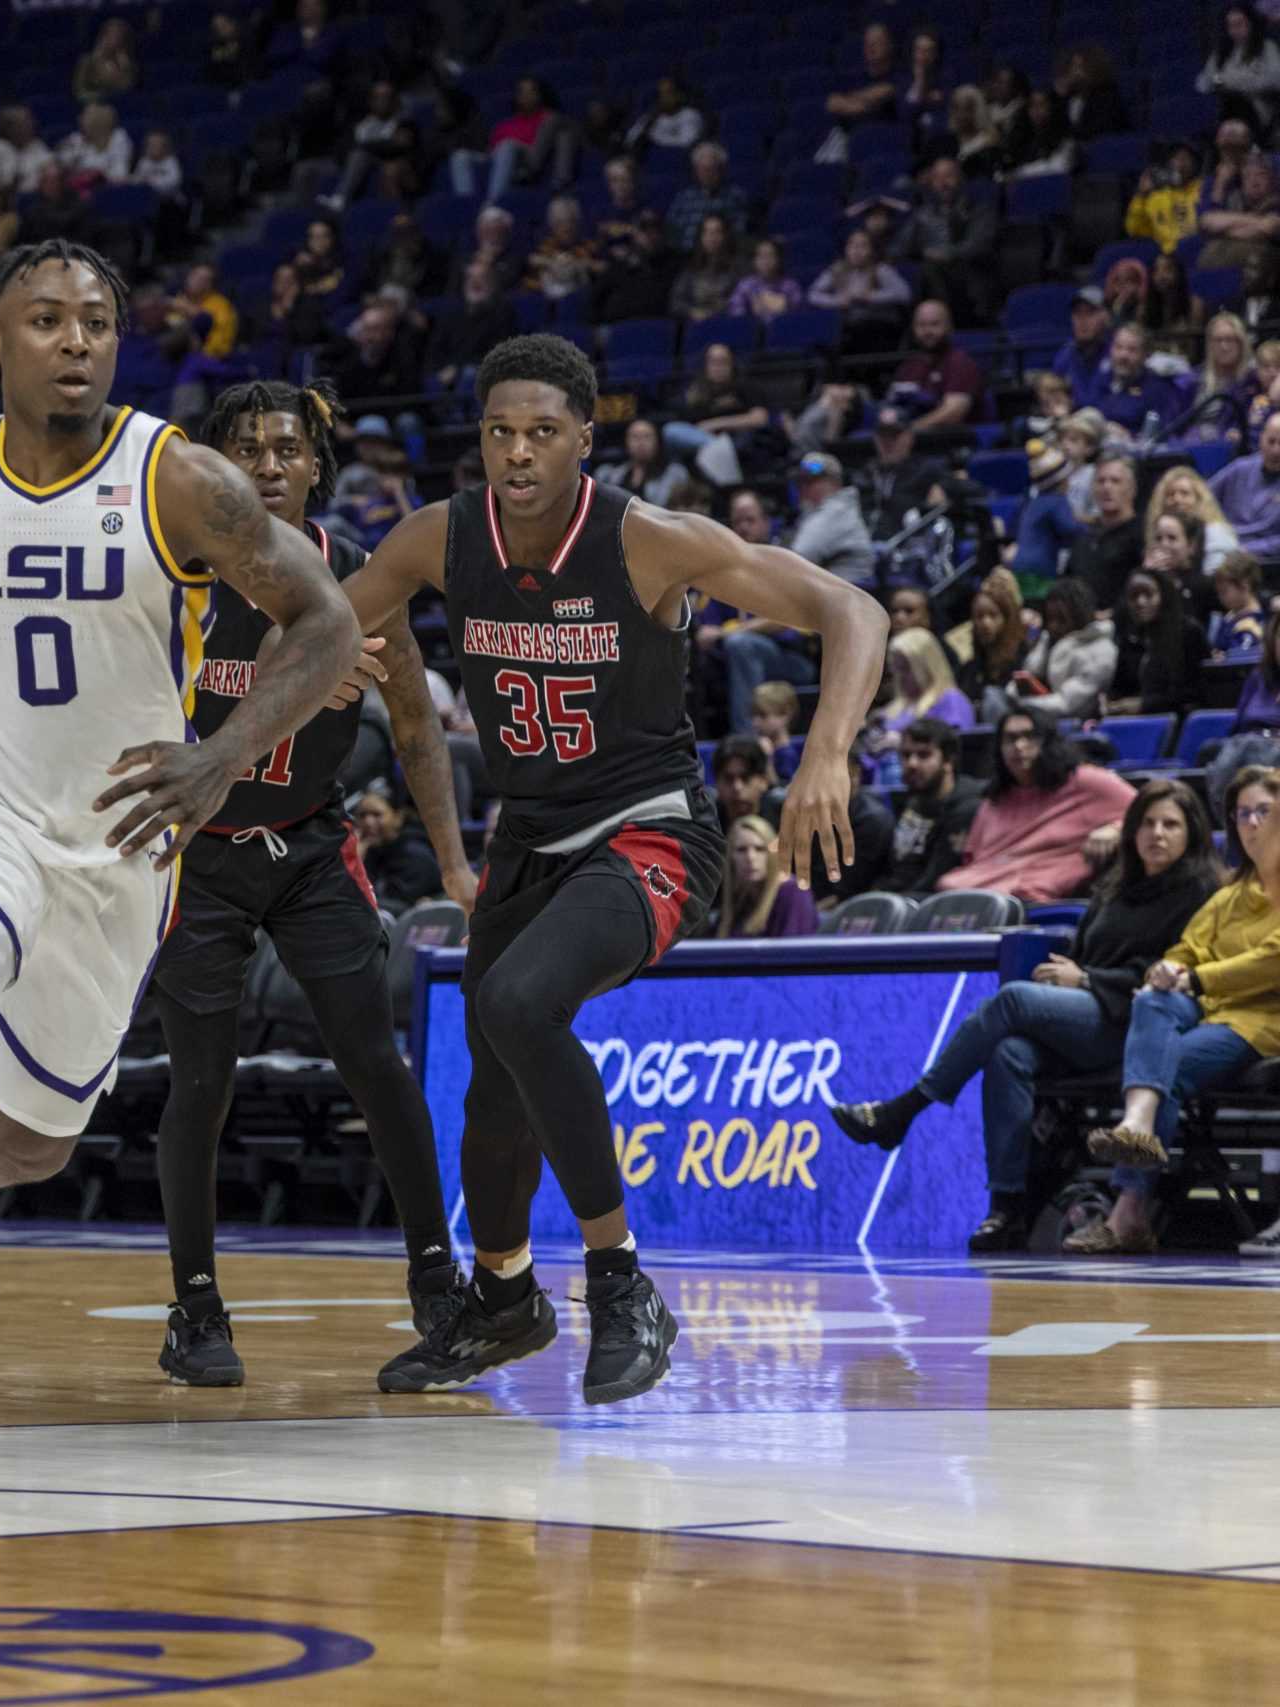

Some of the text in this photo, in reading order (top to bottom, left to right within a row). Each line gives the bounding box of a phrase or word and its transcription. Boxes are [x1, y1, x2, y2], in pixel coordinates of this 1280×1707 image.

[553, 596, 594, 618] SBC
[14, 615, 78, 707] 0
[463, 617, 620, 664] ARKANSAS STATE
[495, 668, 597, 764] 35
[238, 732, 293, 787] 1
[677, 1117, 820, 1190] ROAR
